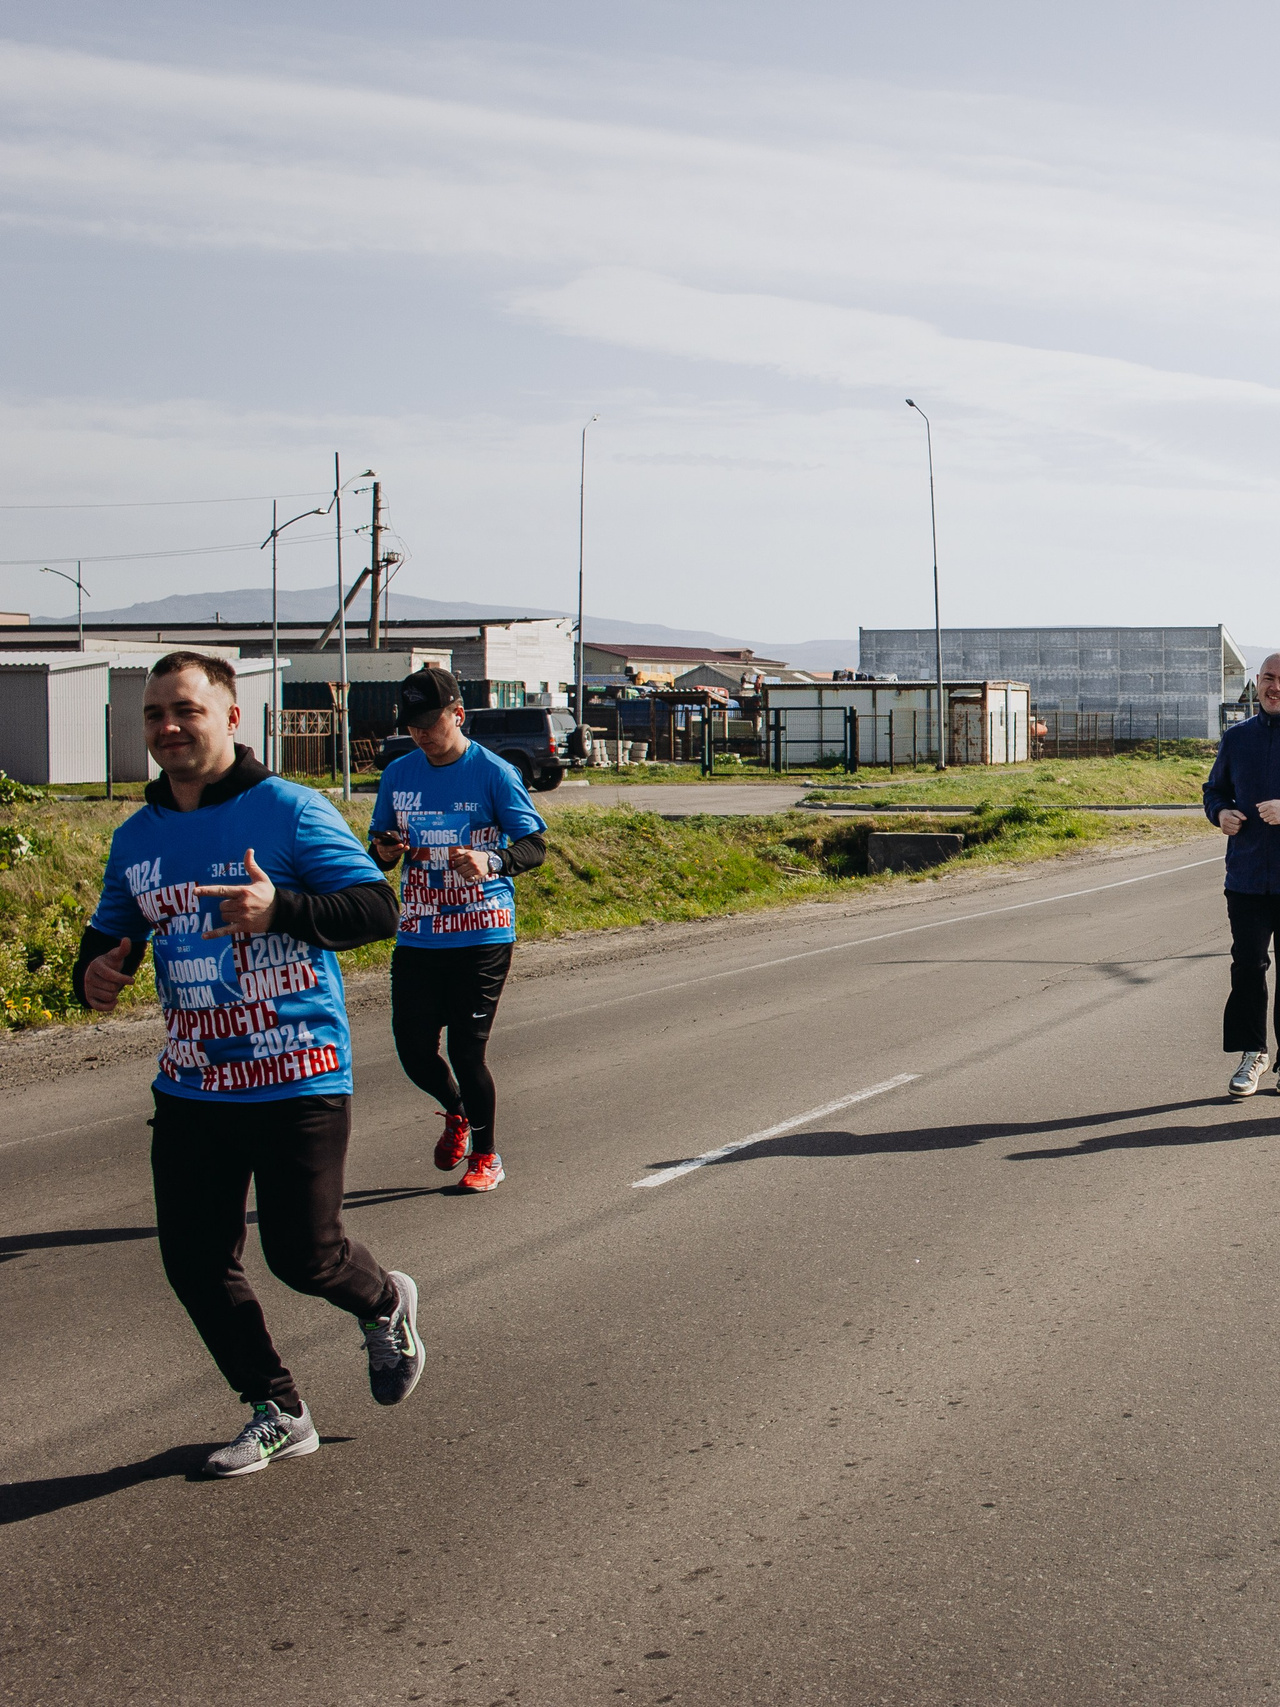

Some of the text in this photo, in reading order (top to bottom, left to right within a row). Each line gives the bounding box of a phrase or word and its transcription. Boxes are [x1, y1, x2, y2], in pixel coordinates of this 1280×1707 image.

[393, 791, 422, 810] 2024
[420, 829, 458, 845] 20065
[125, 857, 162, 896] 2024
[404, 884, 484, 906] #ГОРДОСТЬ
[432, 909, 511, 935] #ЕДИНСТВО
[168, 956, 218, 984] 40006
[250, 1021, 315, 1059] 2024
[200, 1043, 340, 1092] #ЕДИНСТВО
